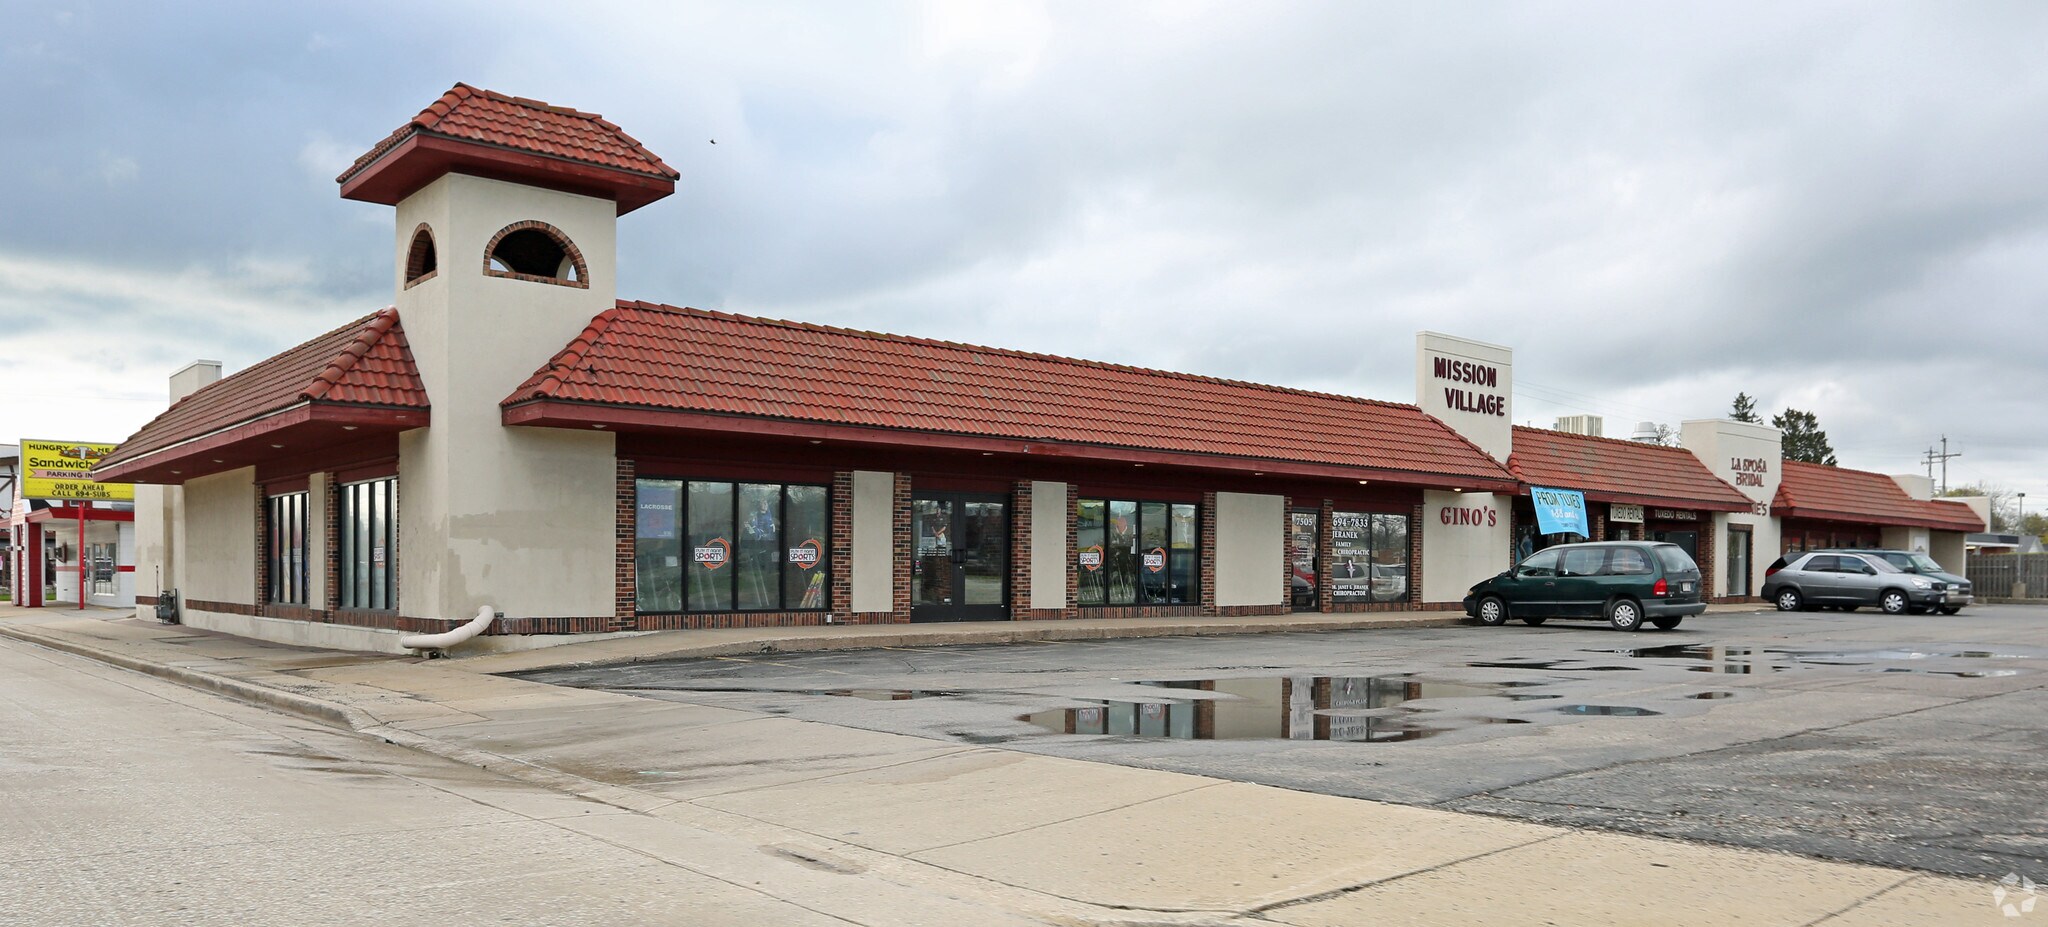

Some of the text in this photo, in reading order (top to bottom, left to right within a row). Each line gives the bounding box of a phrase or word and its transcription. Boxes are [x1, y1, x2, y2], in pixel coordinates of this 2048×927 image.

[1434, 357, 1497, 388] MISSION
[1445, 387, 1505, 416] VILLAGE
[1731, 457, 1741, 471] LA
[1736, 472, 1764, 487] BRIDAL
[1535, 490, 1560, 506] PROM
[1440, 506, 1496, 527] GINO'S
[1655, 509, 1697, 520] TUXEDO RENTALS
[1296, 517, 1313, 526] 7505
[1333, 517, 1368, 527] 694-7833
[1332, 530, 1358, 539] JERANEK
[695, 552, 722, 560] SPORTS
[790, 553, 815, 561] SPORTS
